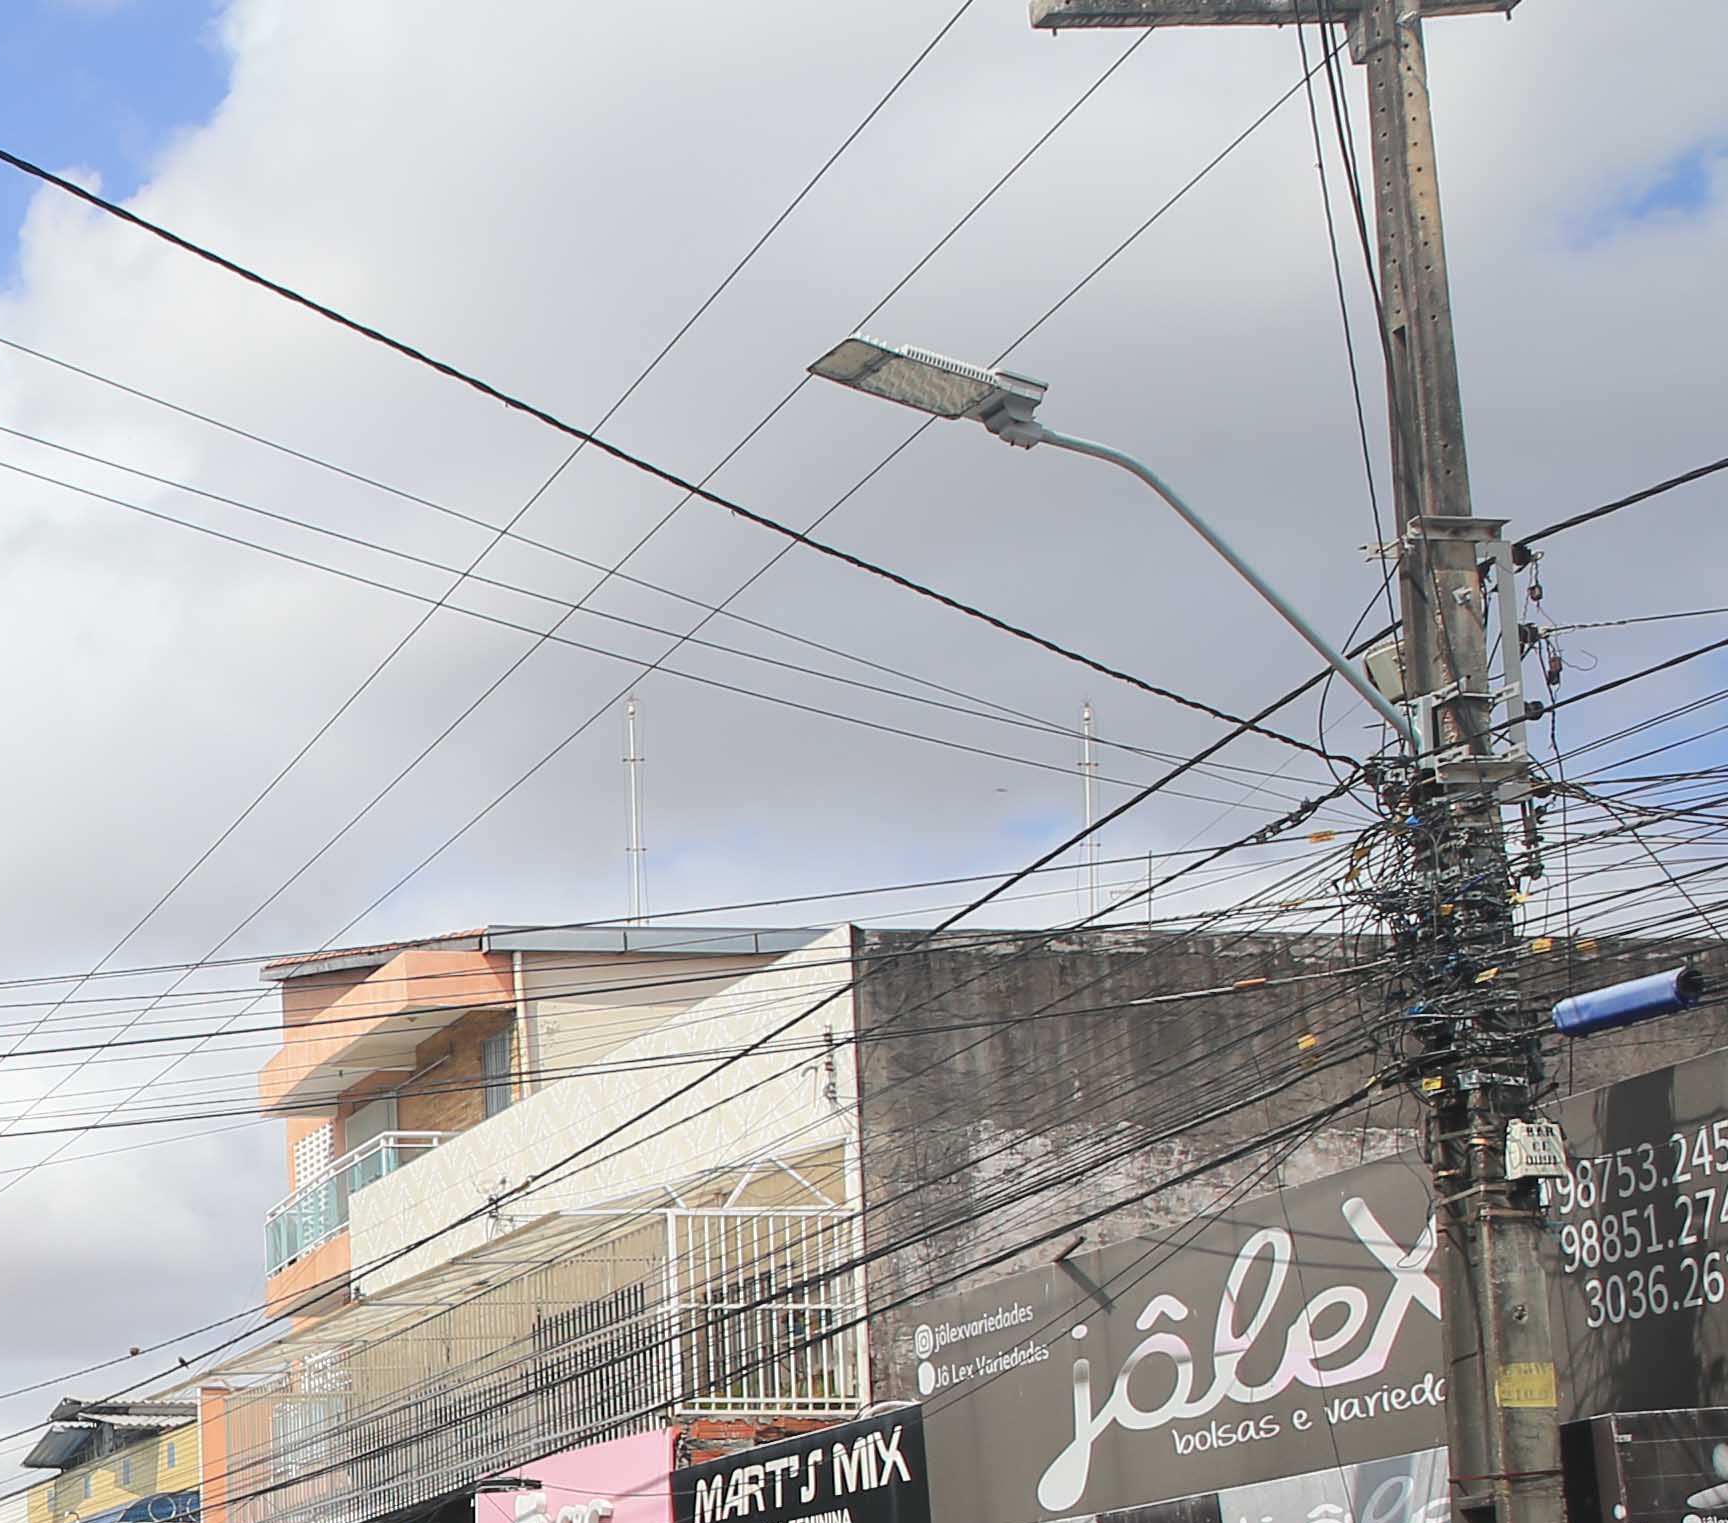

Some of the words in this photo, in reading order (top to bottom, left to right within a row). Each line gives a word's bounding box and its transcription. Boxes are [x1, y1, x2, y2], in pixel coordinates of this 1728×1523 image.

[1556, 1120, 1728, 1214] 98753.245
[934, 1302, 1034, 1352] jôlexvariedades
[951, 1363, 975, 1383] Lex
[975, 1341, 1050, 1377] Variedades
[1172, 1415, 1281, 1454] bolsas
[1292, 1409, 1313, 1430] e
[832, 1425, 912, 1497] MIX
